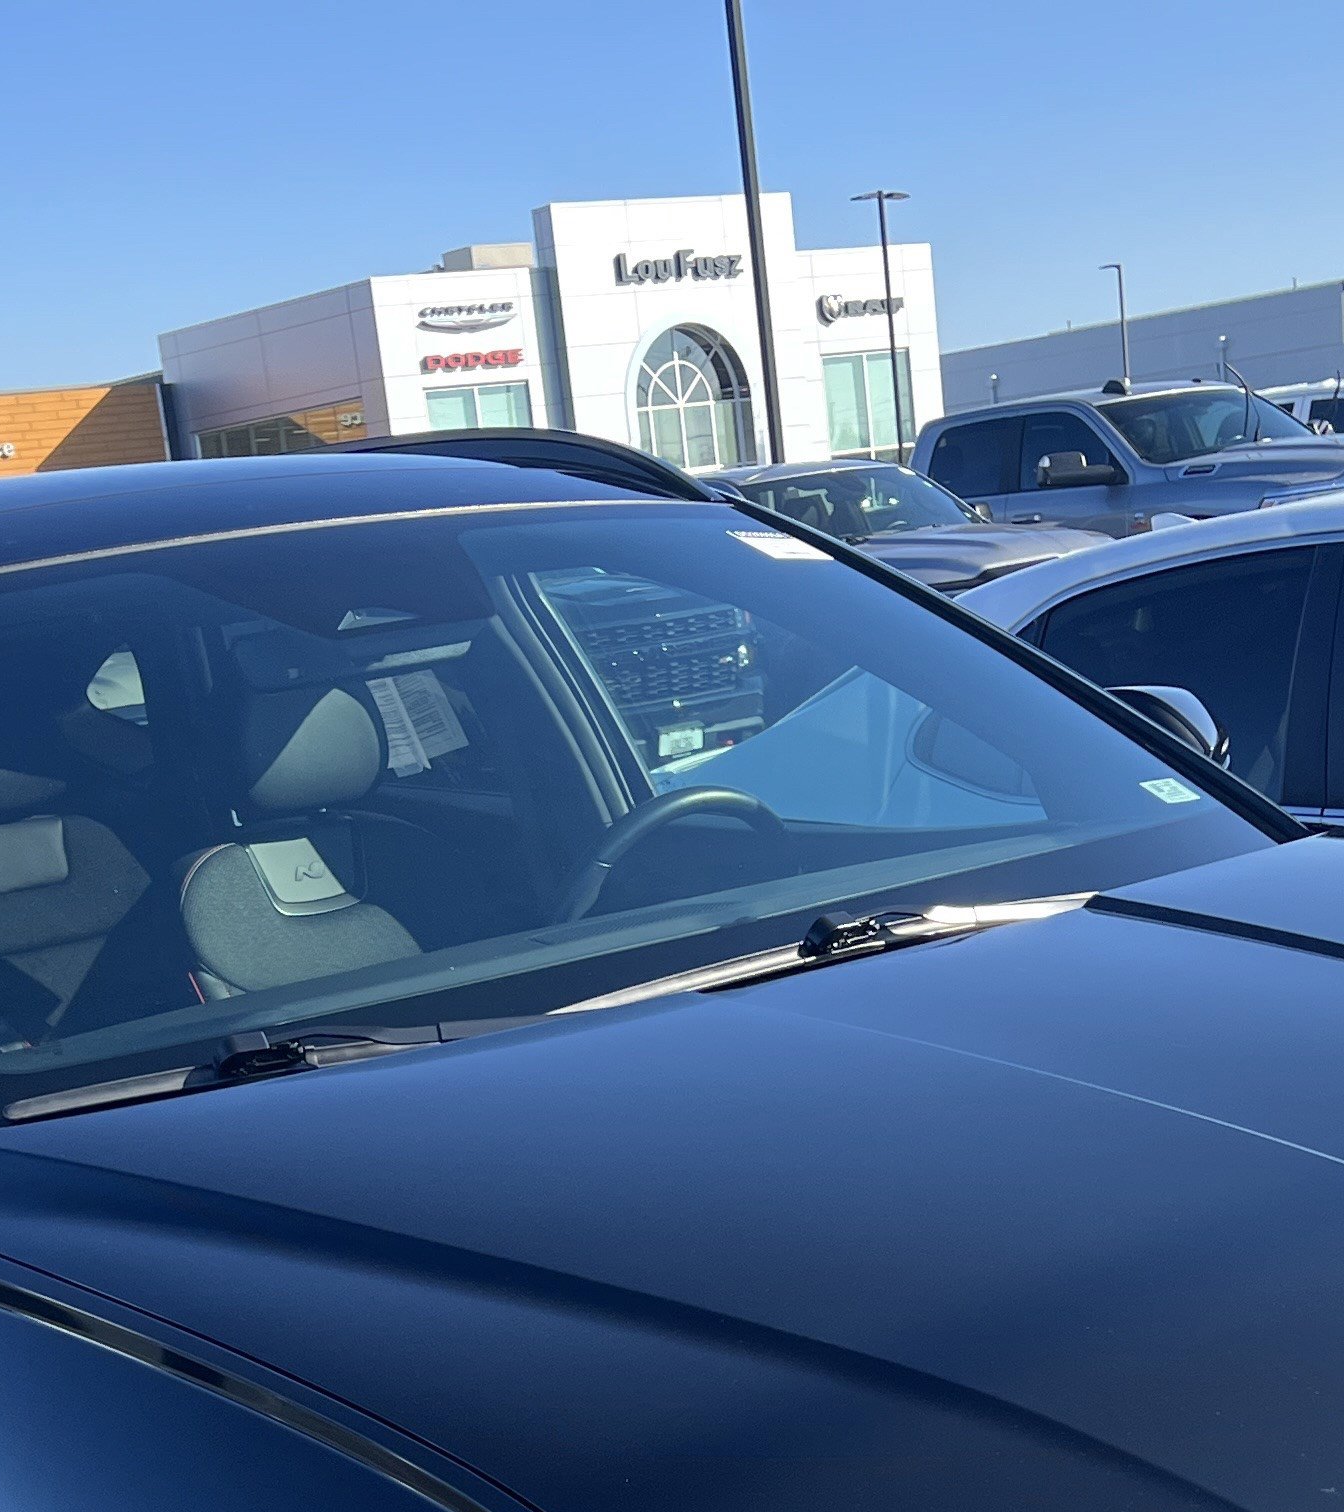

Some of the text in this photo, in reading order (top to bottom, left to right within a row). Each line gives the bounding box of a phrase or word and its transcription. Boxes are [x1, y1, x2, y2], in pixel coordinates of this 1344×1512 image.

[614, 249, 743, 286] Lou Fusz
[422, 348, 524, 372] DODGE
